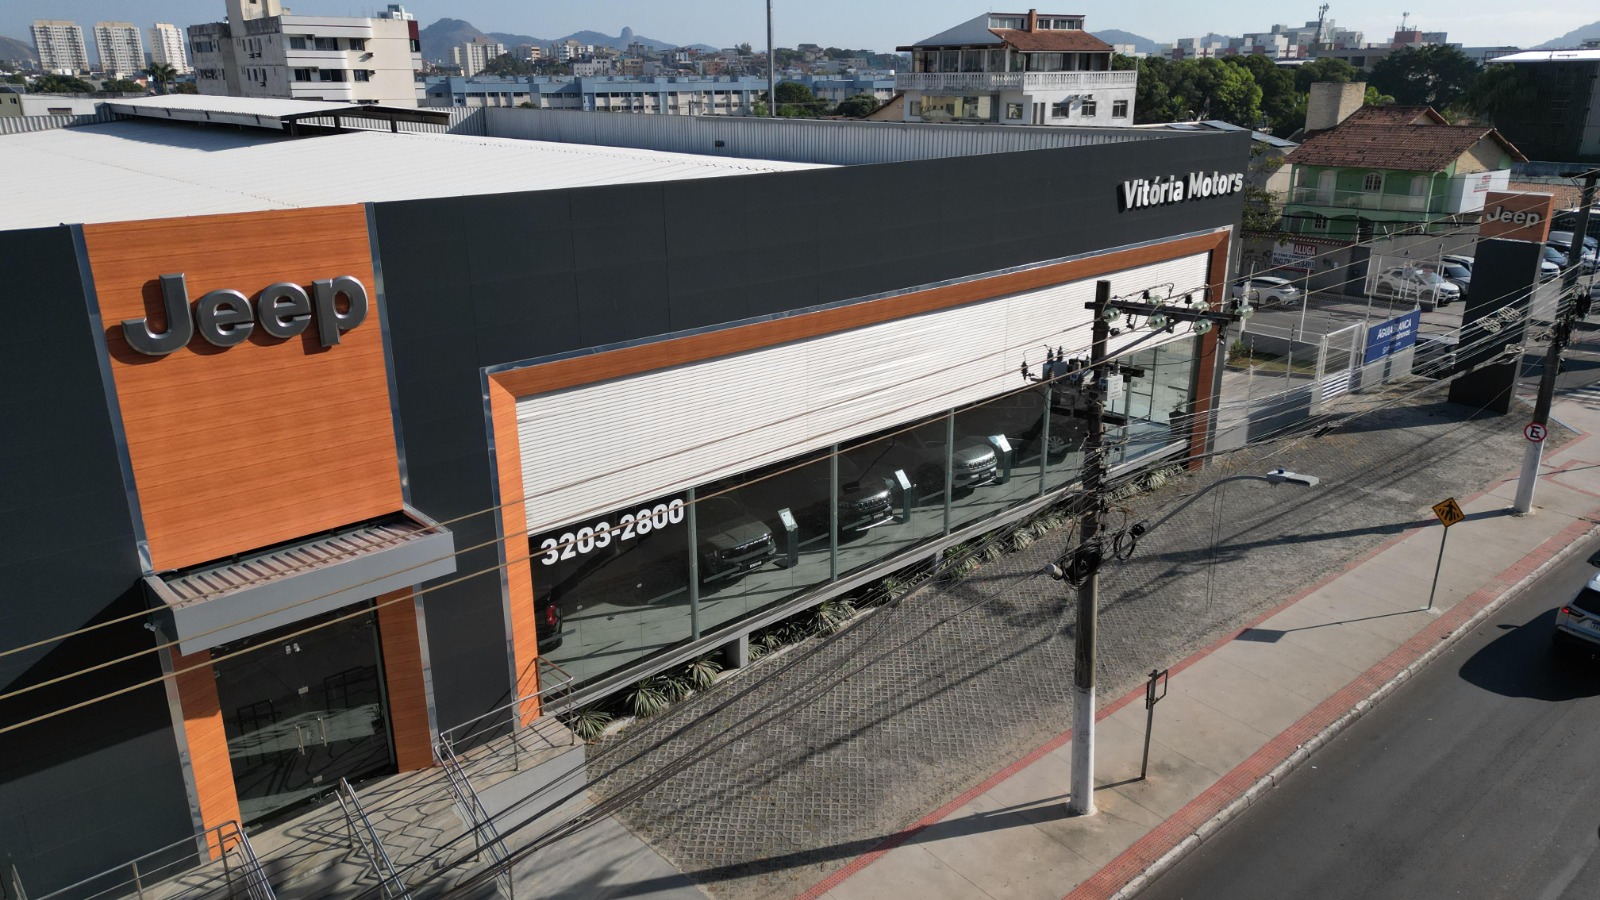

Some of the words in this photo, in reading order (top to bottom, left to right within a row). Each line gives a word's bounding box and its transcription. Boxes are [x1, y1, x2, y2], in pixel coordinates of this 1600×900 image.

[1124, 175, 1184, 209] Vitória
[1188, 171, 1244, 200] Motors
[1486, 206, 1541, 228] Jeep
[1294, 244, 1316, 256] ALUGA
[121, 272, 369, 356] Jeep
[1530, 426, 1541, 439] E
[540, 498, 685, 566] 3203-2800
